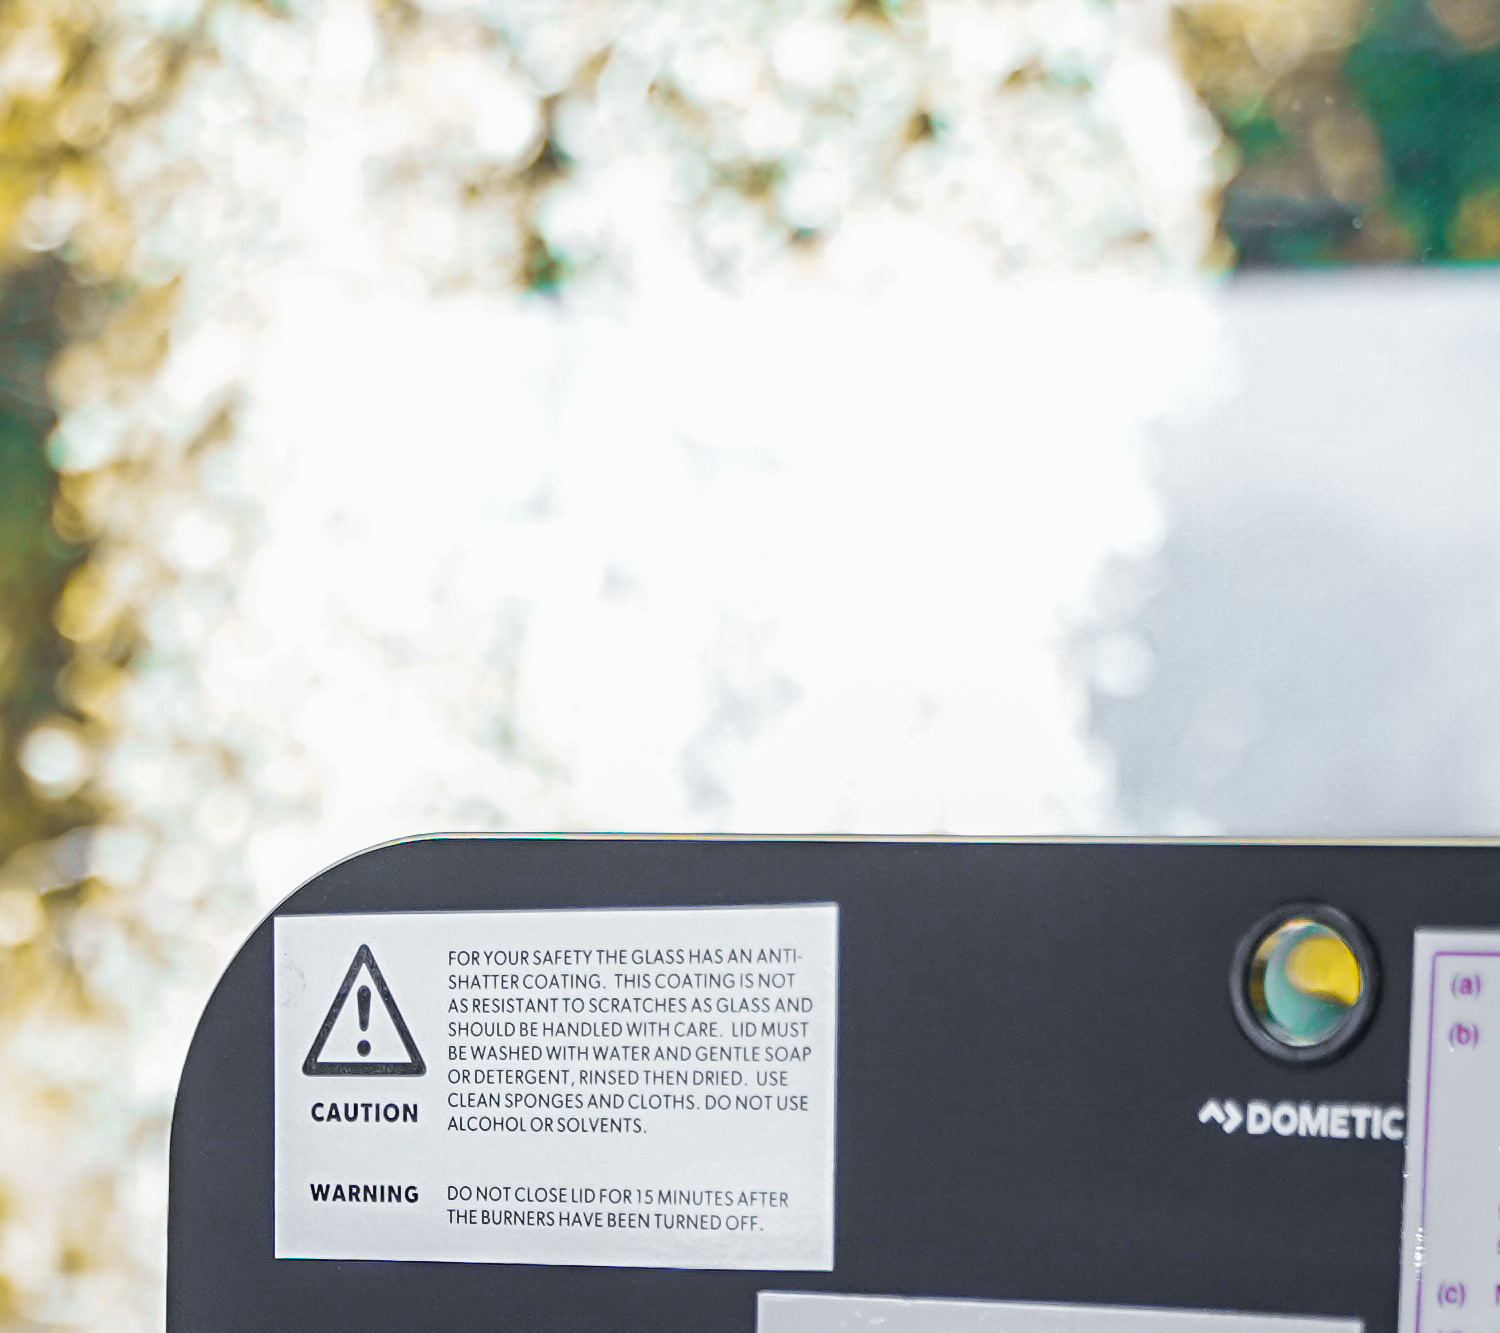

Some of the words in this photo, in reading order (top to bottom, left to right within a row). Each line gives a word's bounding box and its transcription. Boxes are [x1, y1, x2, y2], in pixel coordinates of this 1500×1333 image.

[449, 950, 480, 966] FOR
[483, 950, 529, 966] YOUR
[533, 949, 593, 965] SAFETY
[596, 949, 627, 965] THE
[631, 948, 685, 965] GLASS
[689, 948, 723, 964] HAS
[727, 948, 752, 964] AN
[757, 948, 802, 963] ANTI-
[448, 974, 519, 990] SHATTER
[523, 973, 606, 990] COATING.
[614, 973, 651, 989] THIS
[655, 973, 735, 989] COATING
[740, 973, 754, 989] IS
[759, 973, 795, 988] NOT
[1451, 973, 1482, 997] (a)
[448, 997, 469, 1013] AS
[472, 997, 559, 1013] RESISTANT
[562, 997, 585, 1013] TO
[589, 997, 687, 1013] SCRATCHES
[691, 997, 712, 1013] AS
[716, 997, 771, 1013] GLASS
[775, 997, 813, 1013] AND
[448, 1021, 516, 1037] SHOULD
[520, 1022, 538, 1037] BE
[543, 1021, 623, 1037] HANDLED
[626, 1021, 670, 1037] WITH
[674, 1021, 723, 1037] CARE.
[732, 1022, 757, 1038] LID
[761, 1022, 809, 1038] MUST
[448, 1045, 467, 1061] BE
[470, 1045, 543, 1061] WASHED
[546, 1045, 589, 1061] WITH
[593, 1045, 650, 1061] WATER
[654, 1046, 692, 1061] AND
[695, 1046, 760, 1062] GENTLE
[765, 1046, 812, 1062] SOAP
[448, 1069, 471, 1084] OR
[475, 1069, 575, 1087] DETERGENT,
[580, 1069, 639, 1085] RINSED
[643, 1070, 688, 1086] THEN
[693, 1070, 748, 1086] DRIED.
[757, 1070, 788, 1086] USE
[448, 1092, 500, 1108] CLEAN
[505, 1093, 584, 1109] SPONGES
[587, 1093, 624, 1109] AND
[628, 1094, 700, 1110] CLOTHS.
[705, 1094, 732, 1111] DO
[736, 1095, 773, 1111] NOT
[777, 1095, 808, 1111] USE
[311, 1102, 418, 1123] CAUTION
[1247, 1102, 1406, 1141] DOMETIC
[447, 1116, 527, 1132] ALCOHOL
[530, 1116, 554, 1133] OR
[557, 1117, 647, 1133] SOLVENTS.
[310, 1183, 418, 1203] WARNING
[448, 1185, 473, 1201] DO
[476, 1186, 512, 1202] NOT
[515, 1187, 568, 1203] CLOSE
[571, 1188, 596, 1204] LID
[600, 1188, 632, 1204] FOR
[637, 1189, 654, 1205] 15
[658, 1190, 734, 1206] MINUTES
[738, 1191, 788, 1207] AFTER
[447, 1209, 478, 1225] THE
[481, 1209, 555, 1227] BURNERS
[559, 1212, 603, 1228] HAVE
[607, 1212, 650, 1229] BEEN
[654, 1213, 722, 1230] TURNED
[726, 1215, 763, 1231] OFF.
